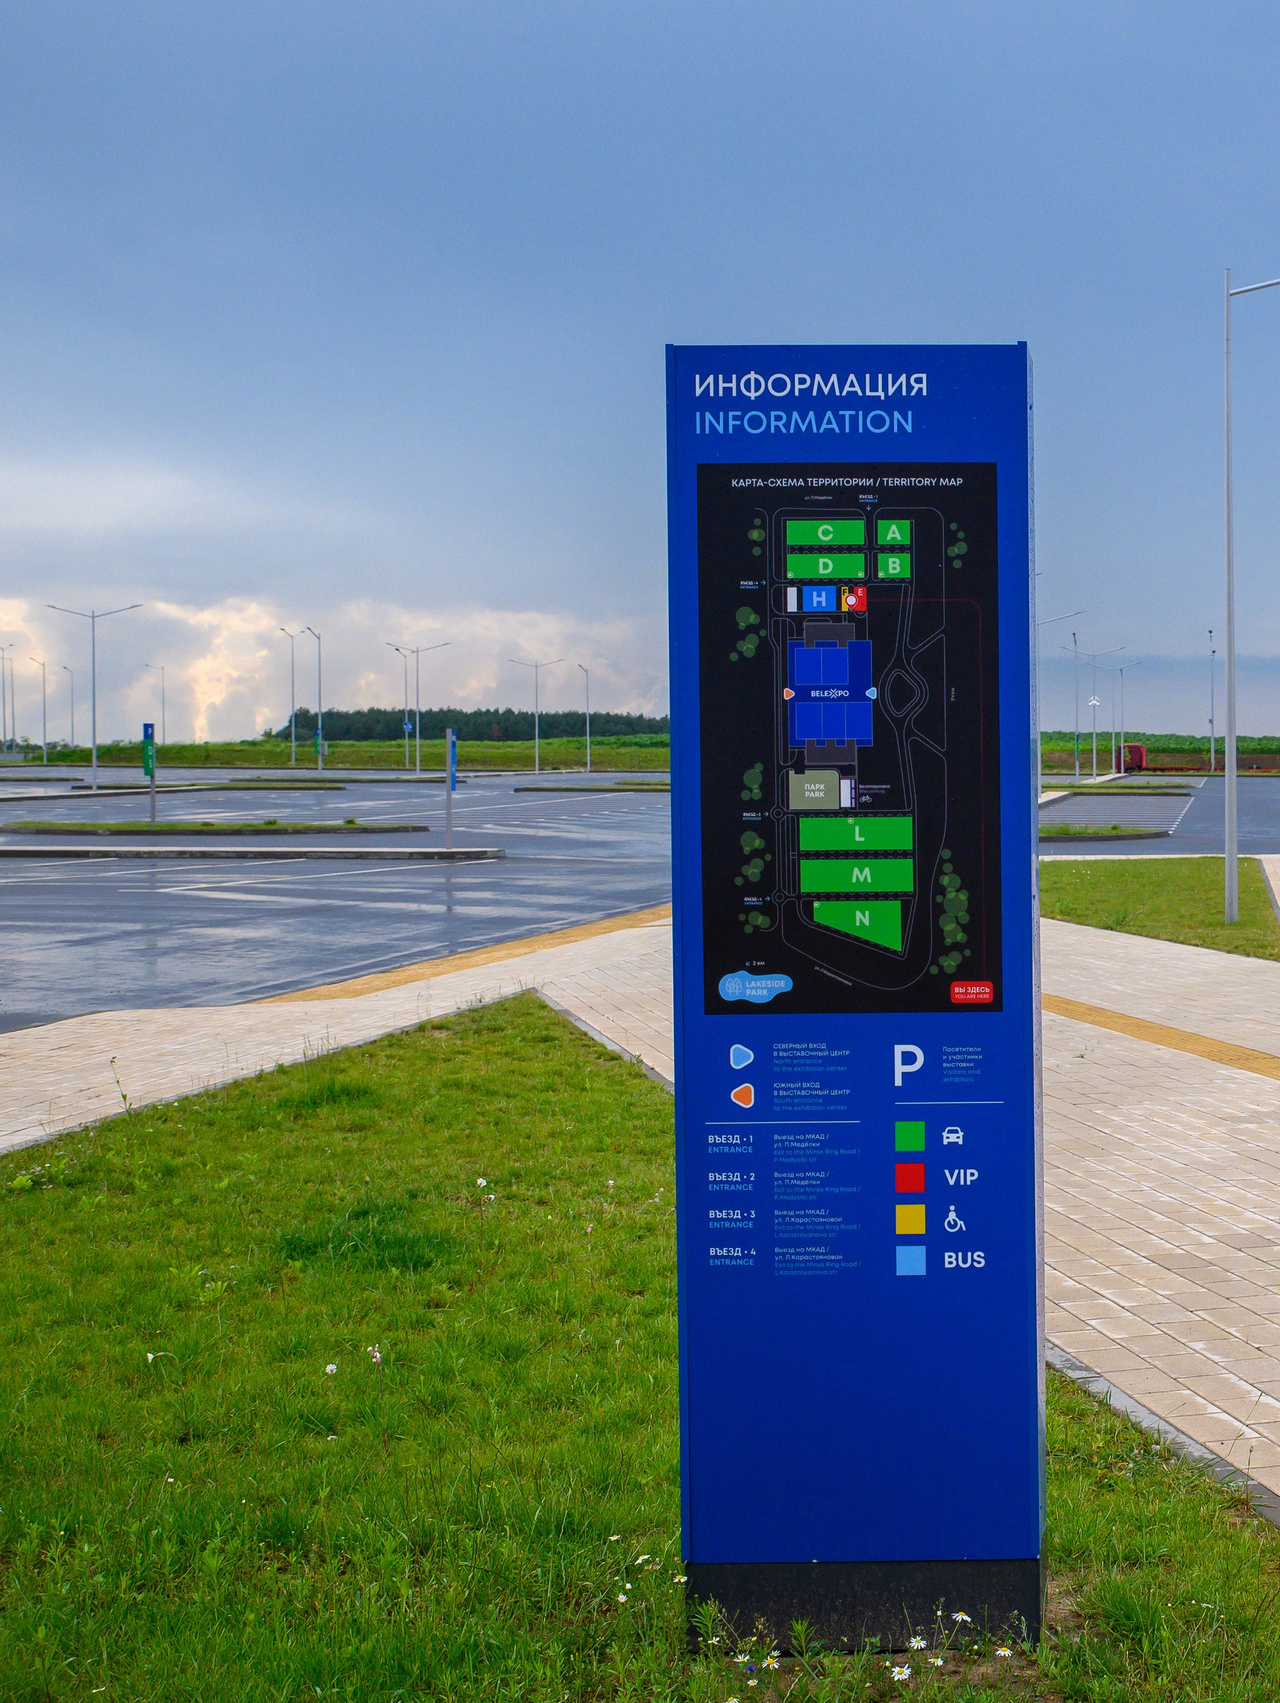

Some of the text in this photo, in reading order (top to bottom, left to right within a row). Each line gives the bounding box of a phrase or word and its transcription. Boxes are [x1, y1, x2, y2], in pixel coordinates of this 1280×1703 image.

[695, 371, 927, 400] ИНФОРМАЦИЯ
[696, 411, 913, 434] INFORMATION
[731, 478, 805, 487] КАРТА-СХЕМА
[807, 478, 874, 487] ТЕРРИТОРИИ
[882, 478, 937, 487] TERRITORY
[939, 478, 963, 486] MAP
[886, 525, 902, 540] A
[819, 558, 833, 574] D
[888, 558, 900, 574] B
[811, 688, 849, 699] BELEXPO
[855, 826, 865, 841] L
[852, 867, 872, 883] M
[855, 911, 870, 926] N
[746, 980, 786, 988] LAKESIDE
[894, 1044, 924, 1086] P
[708, 1135, 741, 1144] ВЪЕЗД
[708, 1172, 741, 1181] ВЪЕЗД
[944, 1169, 979, 1185] VIP
[709, 1210, 755, 1219] ВЪЕЗД 3
[709, 1247, 742, 1256] ВЪЕЗД
[944, 1251, 985, 1268] BUS
